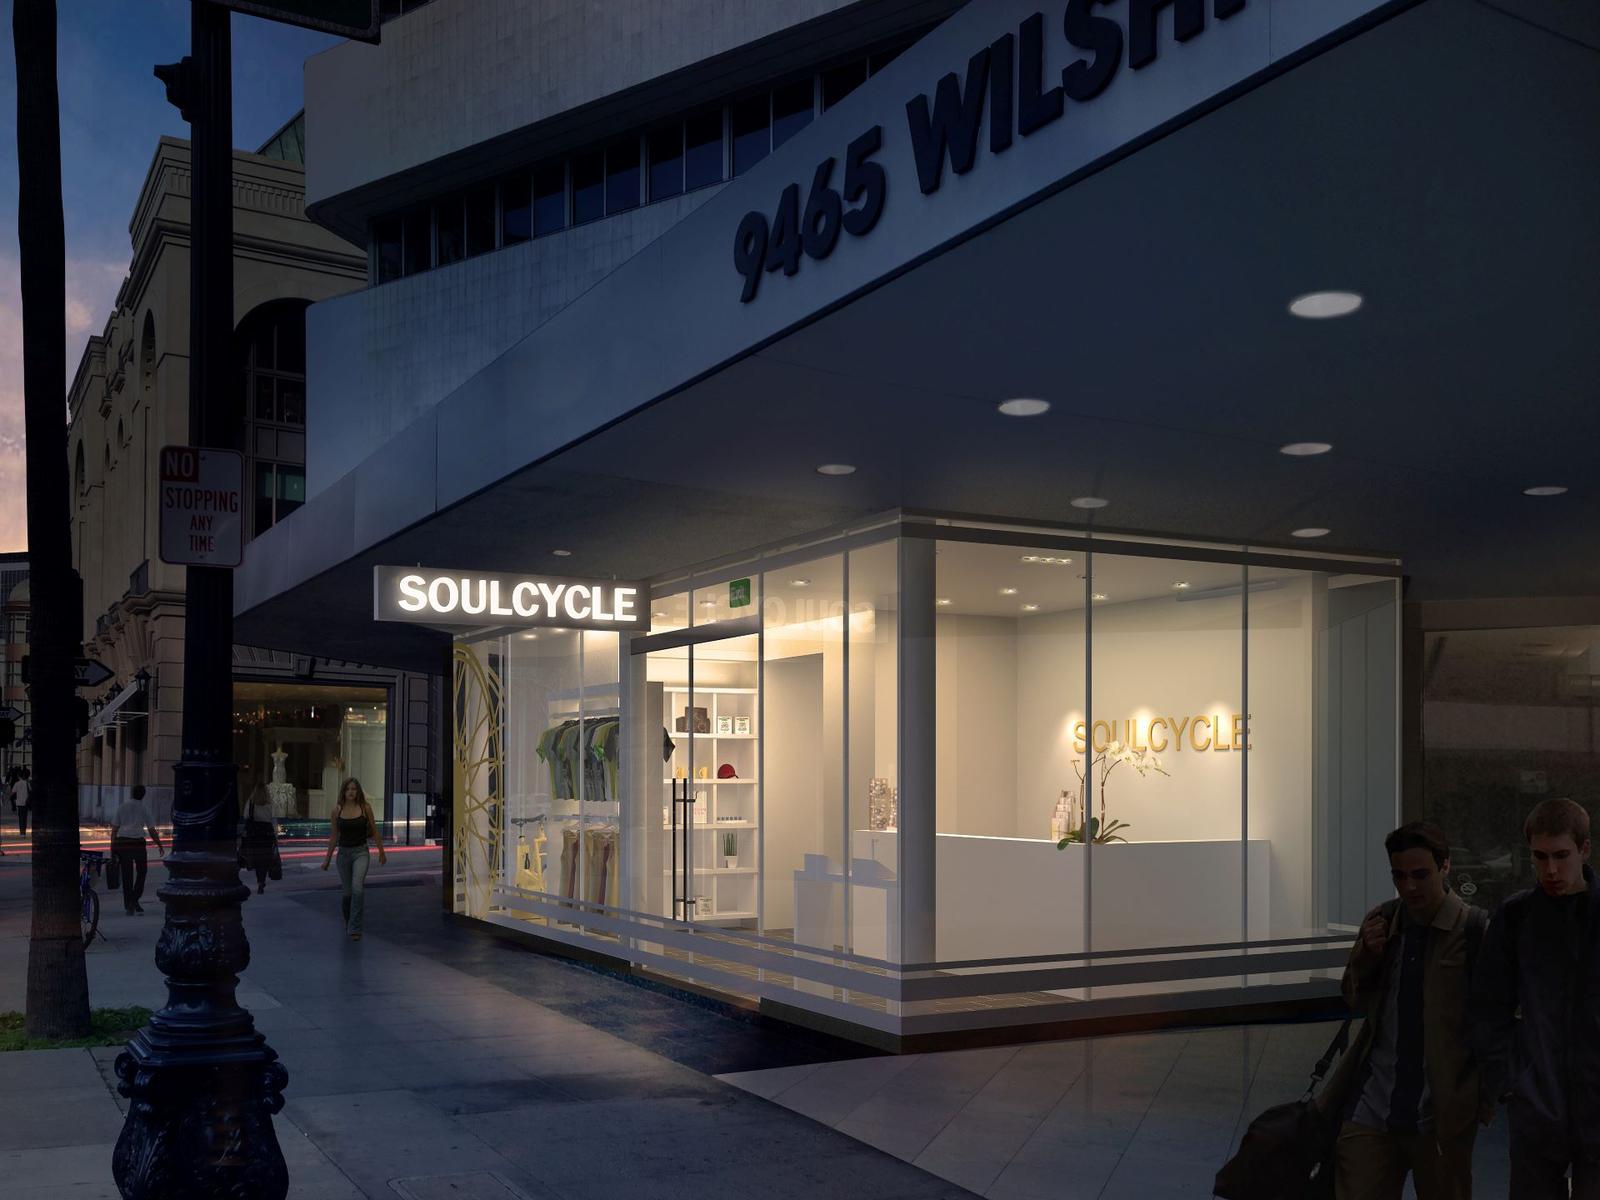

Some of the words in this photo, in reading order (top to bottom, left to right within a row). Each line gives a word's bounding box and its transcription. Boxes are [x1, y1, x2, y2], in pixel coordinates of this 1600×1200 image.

[733, 125, 887, 303] 9465
[906, 0, 1247, 195] WILS
[165, 451, 194, 477] NO
[166, 487, 238, 512] STOPPING
[190, 515, 213, 530] ANY
[189, 535, 214, 552] TIME
[398, 575, 637, 621] SOULCYCLE
[1073, 713, 1252, 753] SOULCYCLE
